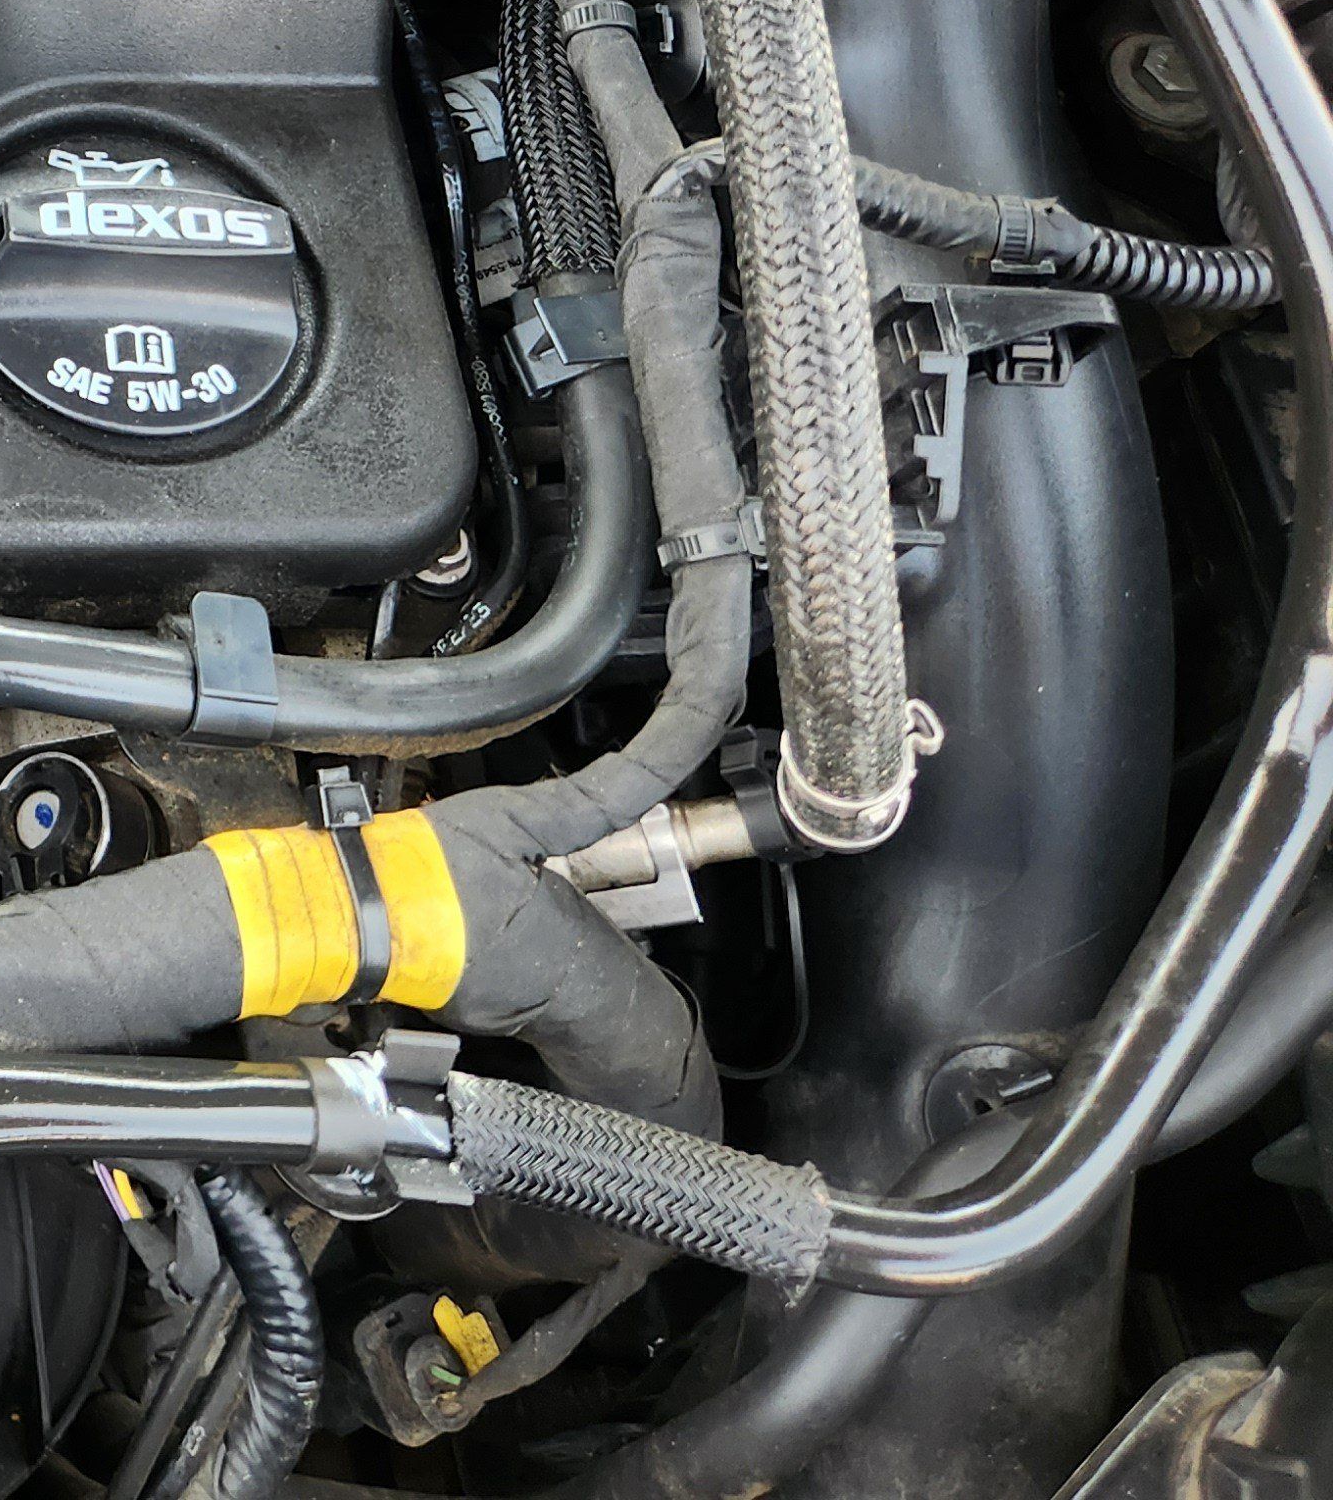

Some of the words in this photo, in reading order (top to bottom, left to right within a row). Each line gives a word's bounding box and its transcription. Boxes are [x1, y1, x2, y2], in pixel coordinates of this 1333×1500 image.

[38, 190, 269, 246] dexos
[46, 356, 114, 406] SAE
[126, 363, 238, 413] 5W-30
